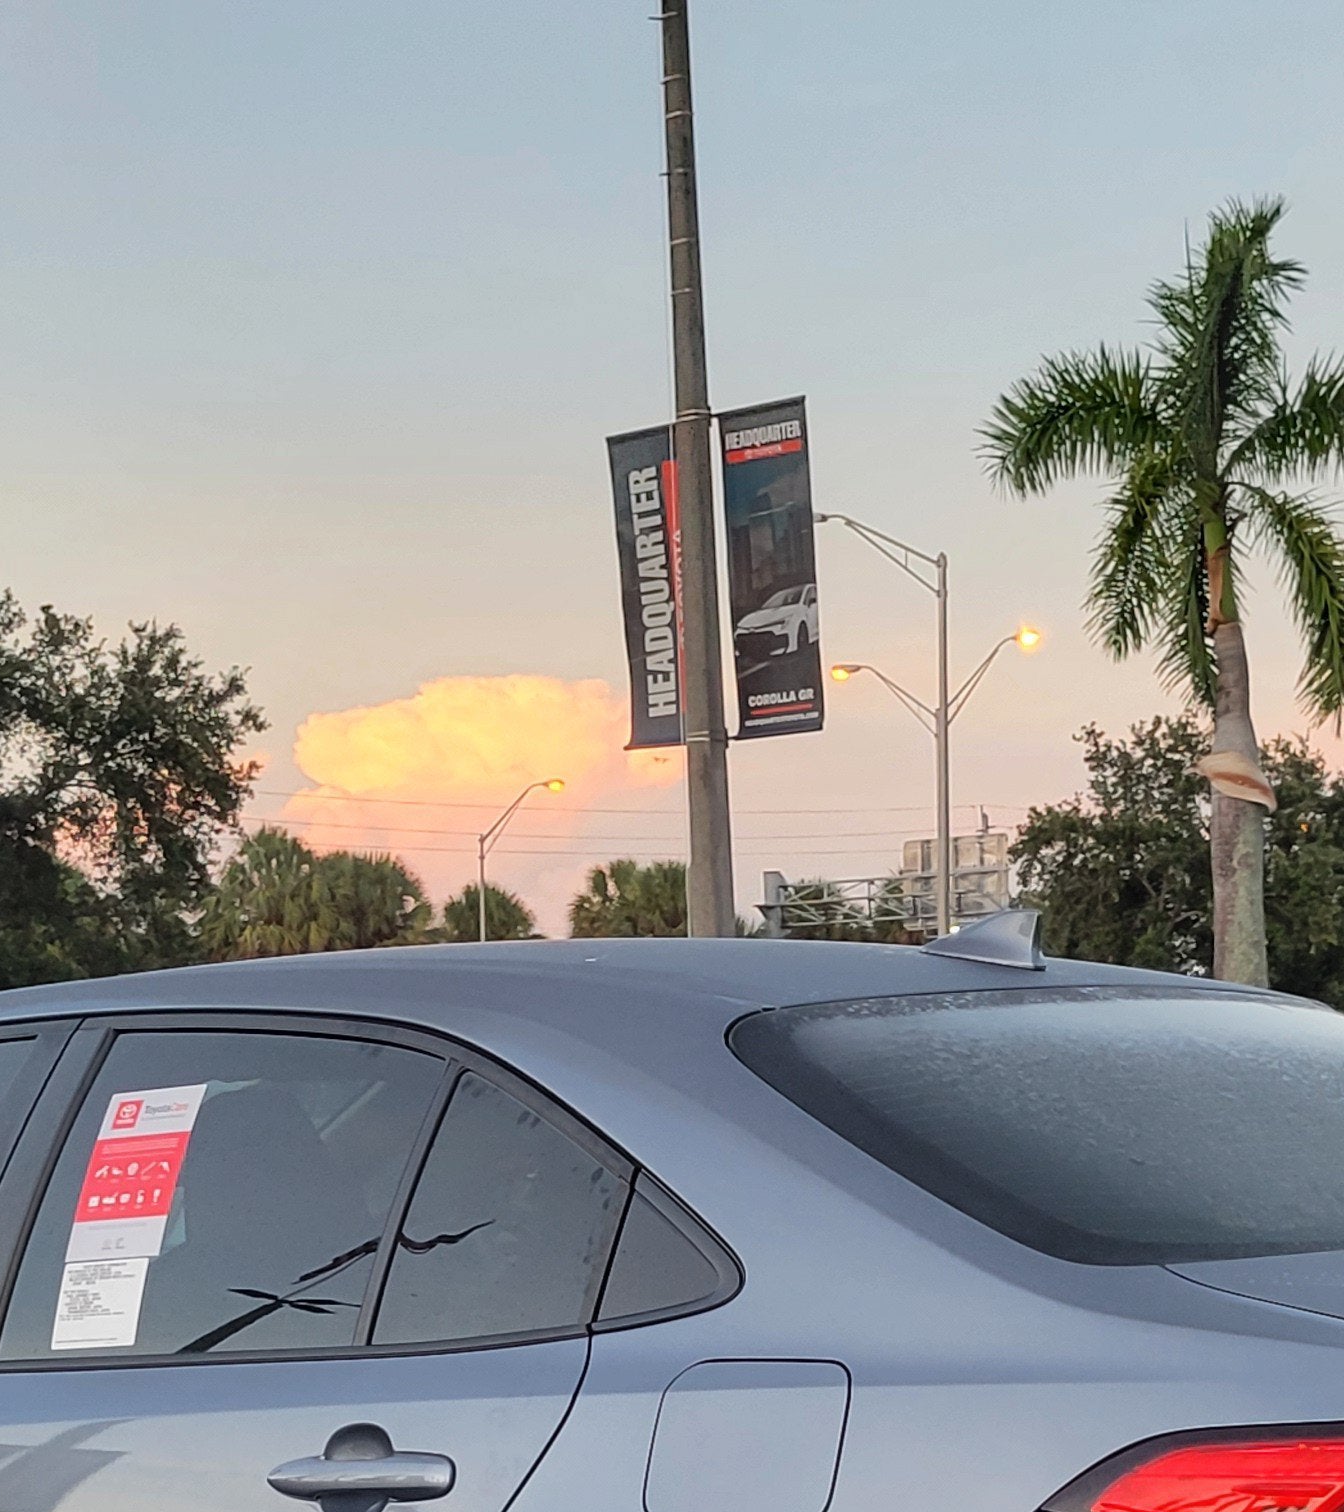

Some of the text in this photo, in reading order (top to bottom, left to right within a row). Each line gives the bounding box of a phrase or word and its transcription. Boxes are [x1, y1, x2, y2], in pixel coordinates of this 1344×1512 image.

[725, 420, 802, 450] HEADQUARTER
[628, 465, 677, 718] HEADQUARTER
[748, 688, 815, 708] COROLLA GR
